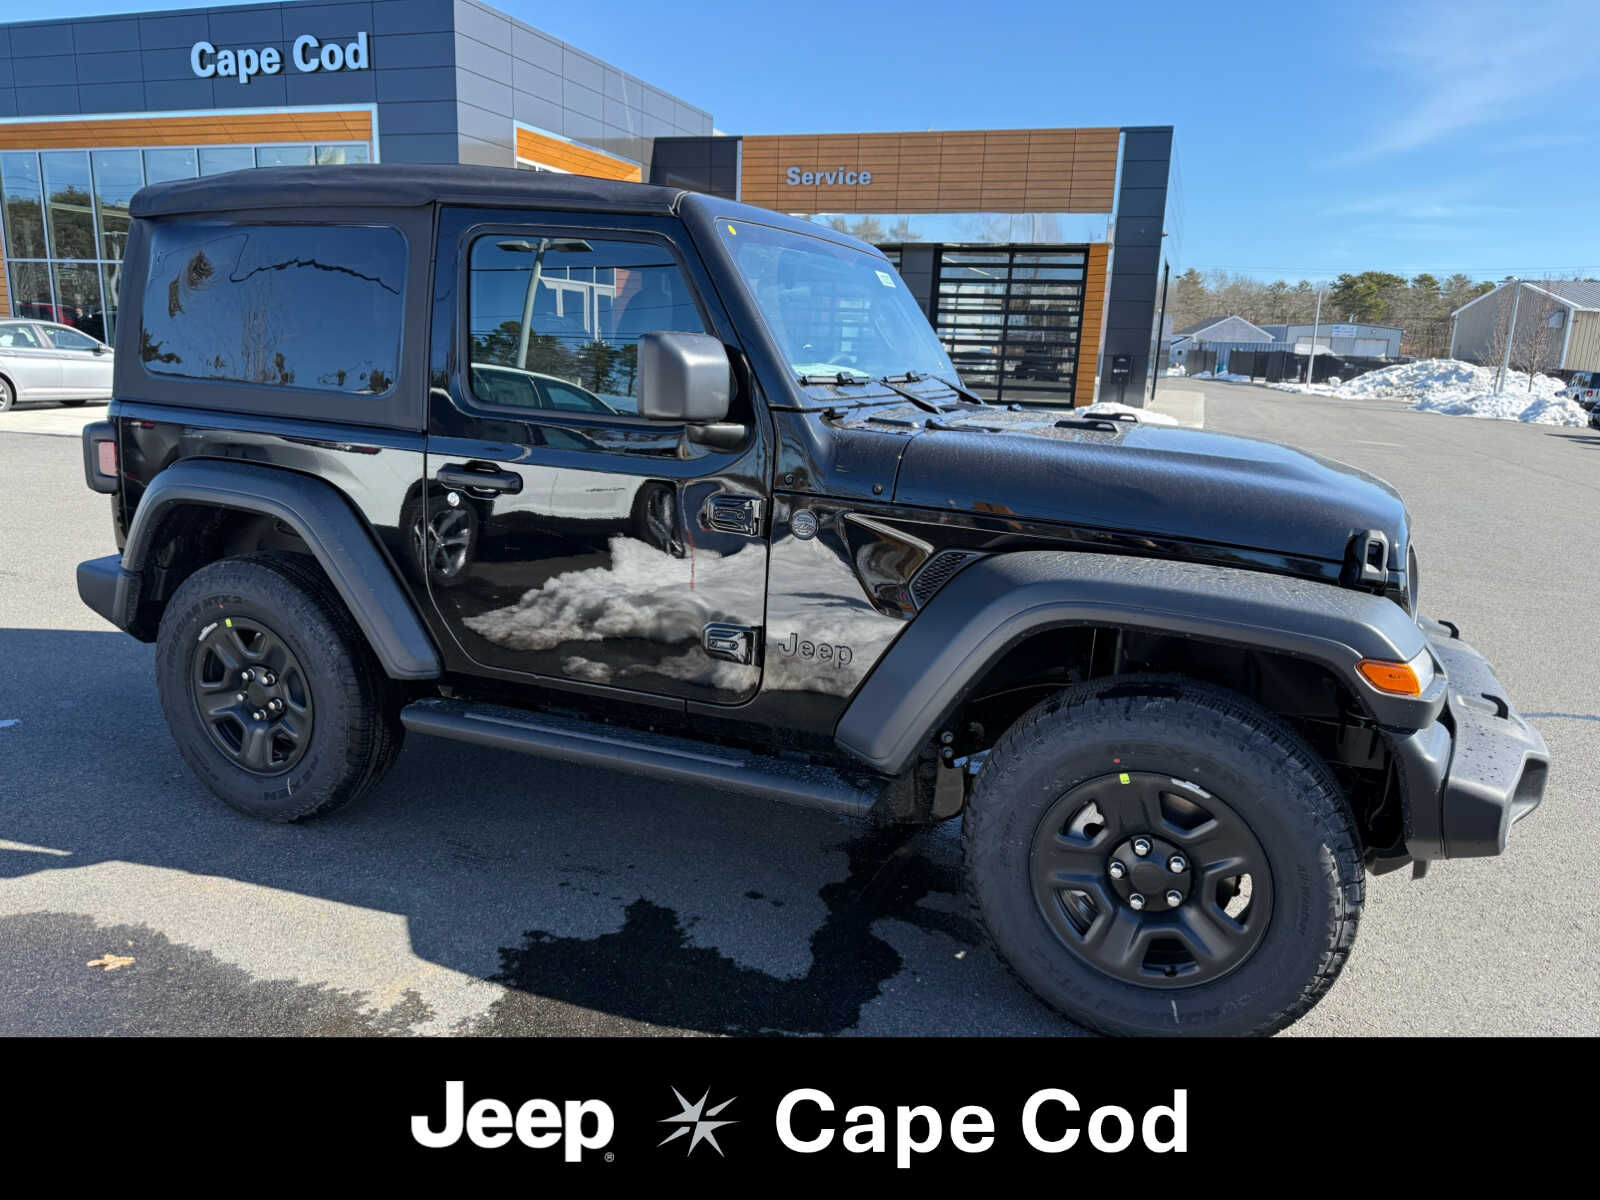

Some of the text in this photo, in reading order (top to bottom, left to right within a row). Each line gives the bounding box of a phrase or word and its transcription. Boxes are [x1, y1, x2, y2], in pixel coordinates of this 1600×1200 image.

[190, 31, 369, 84] Cape Cod
[786, 166, 872, 186] Service
[777, 632, 853, 670] Jeep
